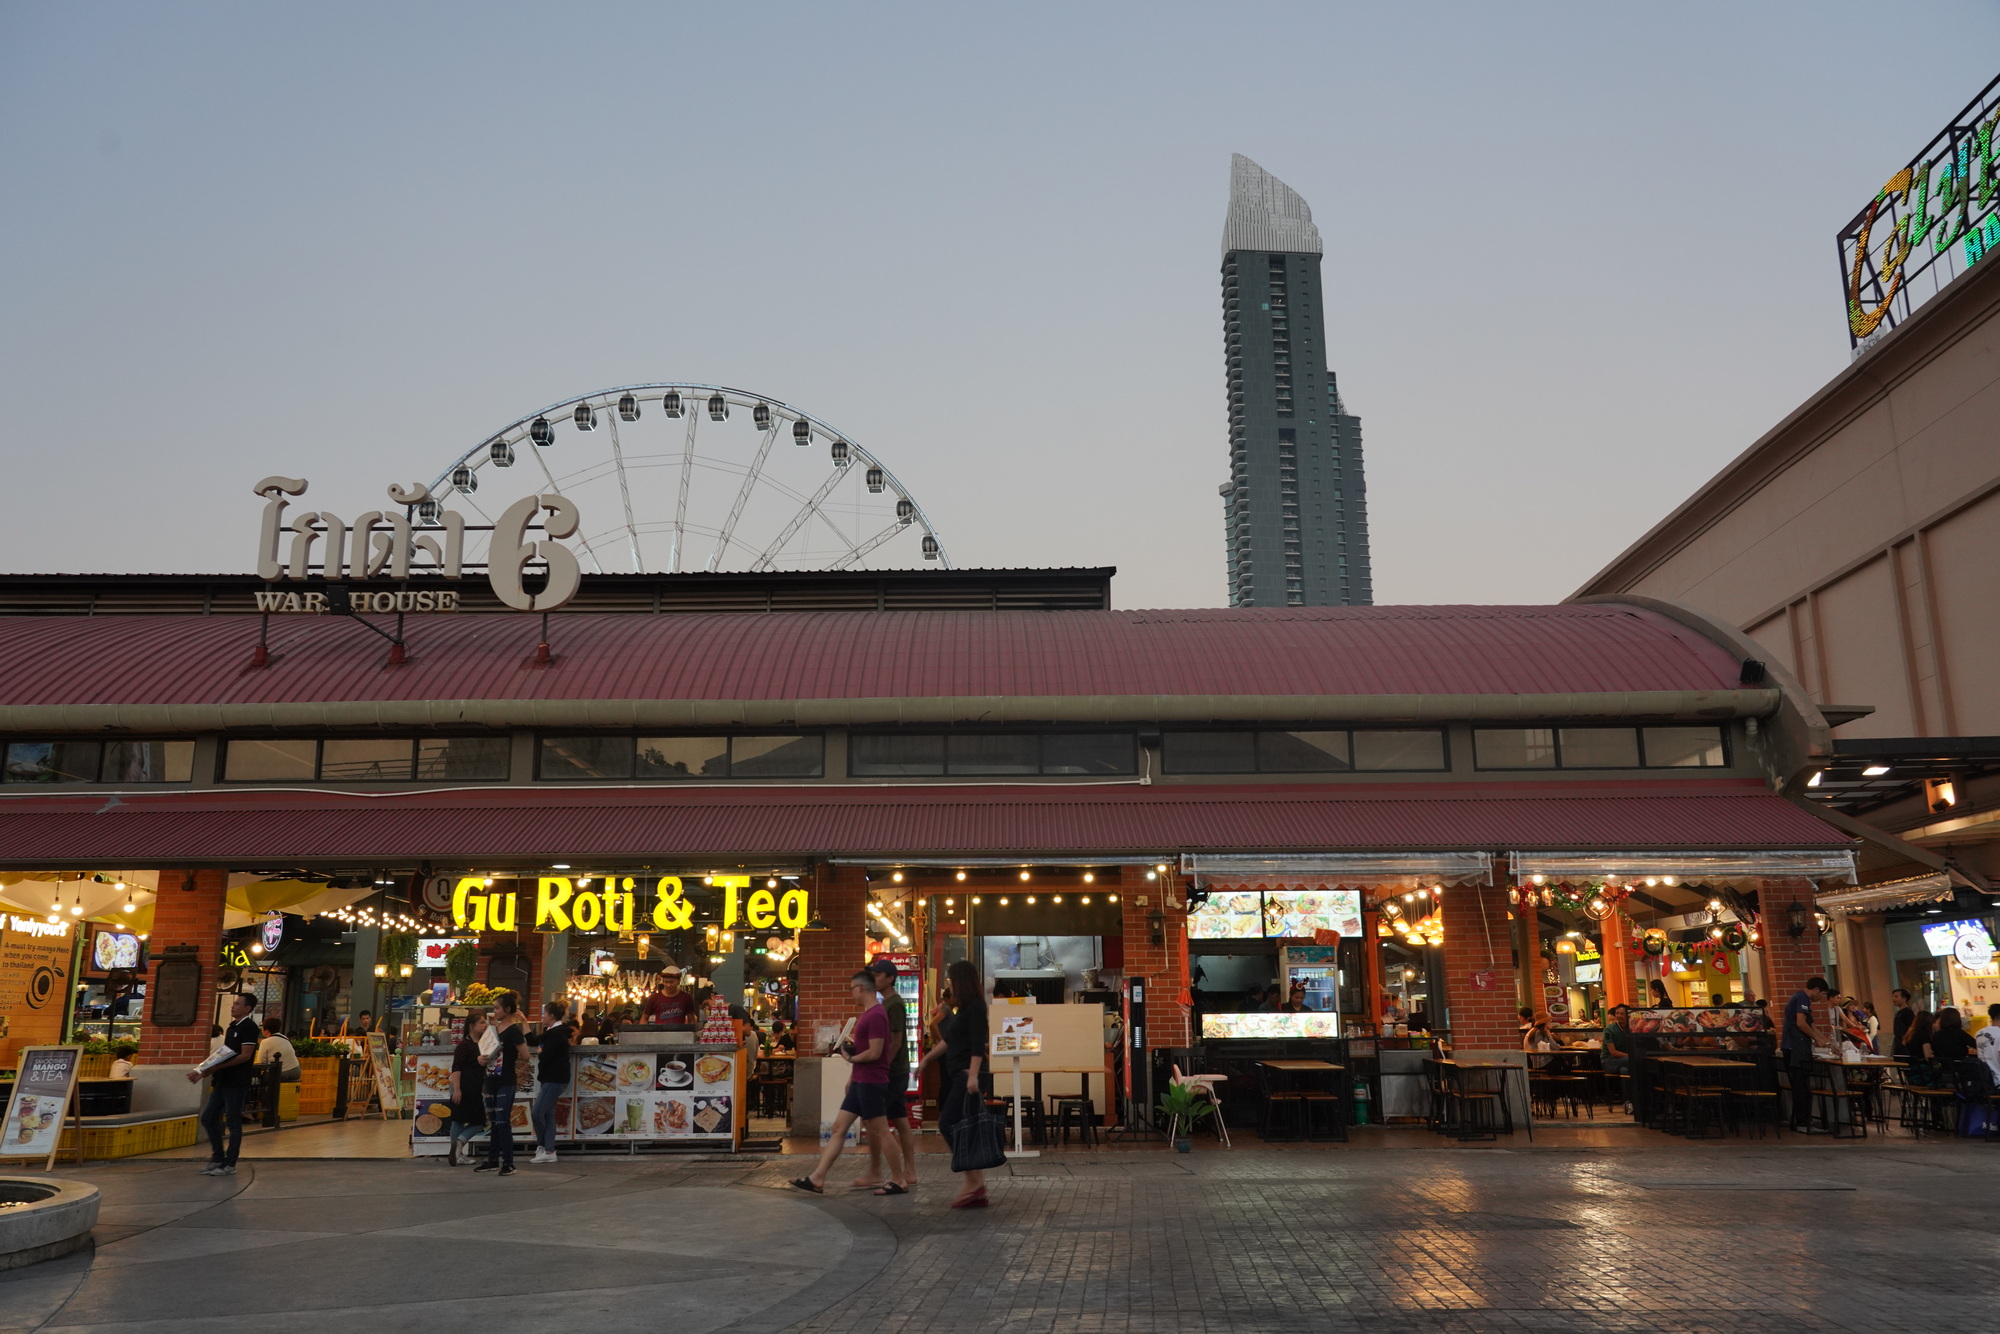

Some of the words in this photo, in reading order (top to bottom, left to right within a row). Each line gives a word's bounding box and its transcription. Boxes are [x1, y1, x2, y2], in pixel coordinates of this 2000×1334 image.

[488, 493, 581, 613] 6
[254, 590, 460, 614] WARHOUSE
[452, 877, 516, 932] Gu
[536, 877, 634, 932] Roti
[653, 876, 694, 931] &
[712, 875, 809, 930] Tea
[27, 944, 36, 952] try
[37, 945, 56, 954] mango
[3, 951, 20, 959] when
[10, 961, 35, 969] thailand
[32, 1063, 67, 1071] MANGO
[30, 1070, 40, 1081] &
[41, 1070, 64, 1081] TEA
